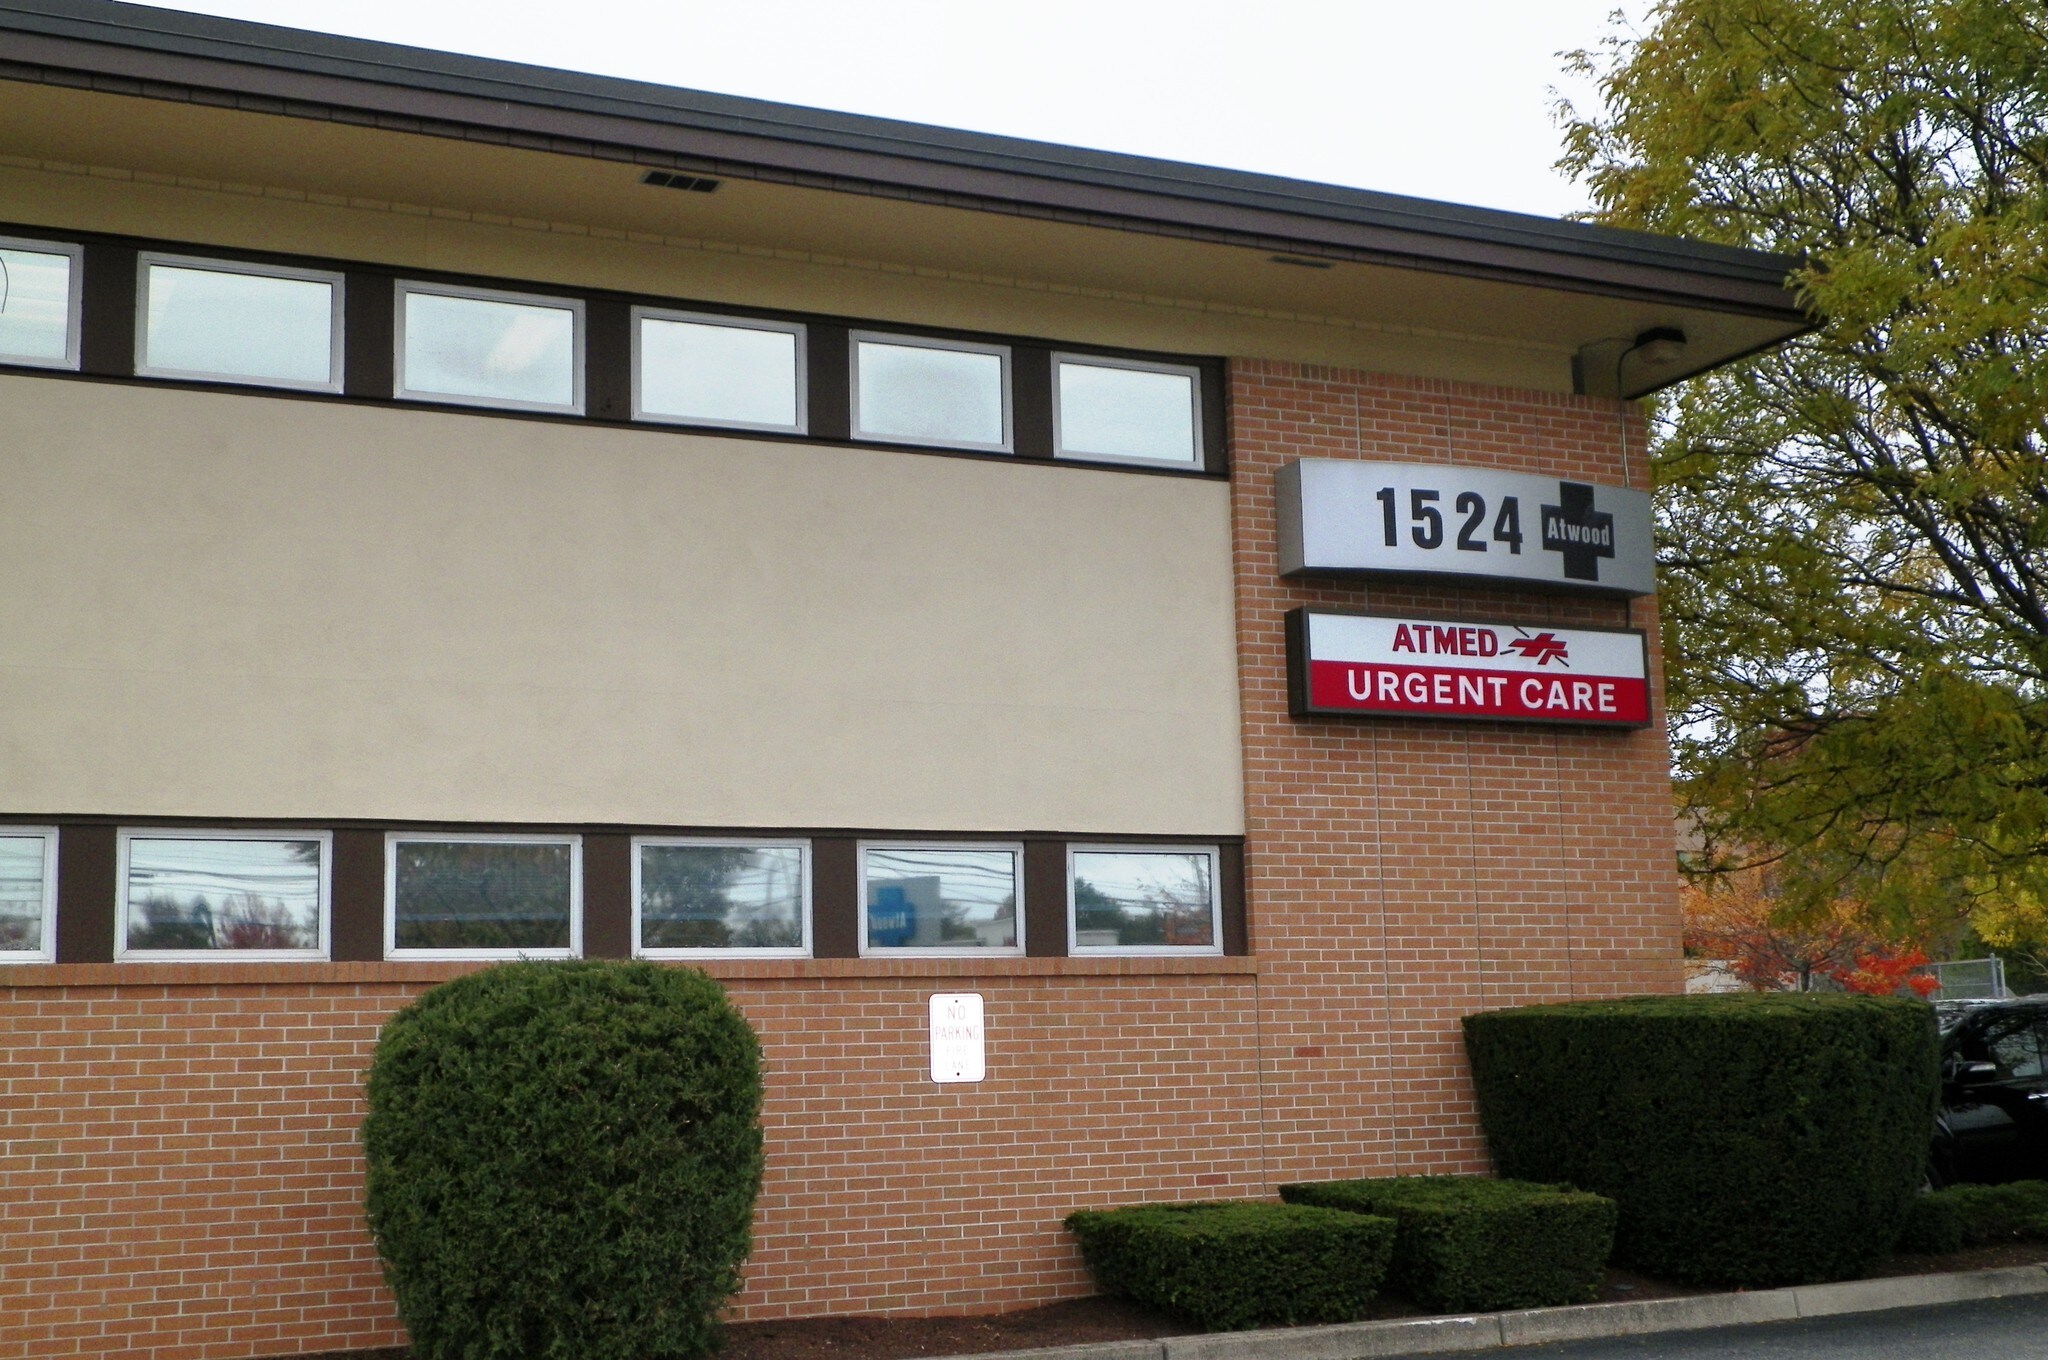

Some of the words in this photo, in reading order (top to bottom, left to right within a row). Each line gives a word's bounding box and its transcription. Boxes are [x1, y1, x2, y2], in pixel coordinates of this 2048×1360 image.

[1376, 487, 1523, 555] 1524
[1547, 516, 1611, 547] Atwood
[1392, 623, 1499, 658] ATMED
[1347, 668, 1508, 707] URGENT
[1519, 678, 1617, 713] CARE
[947, 1005, 966, 1020] NO
[935, 1025, 979, 1040] PARKING
